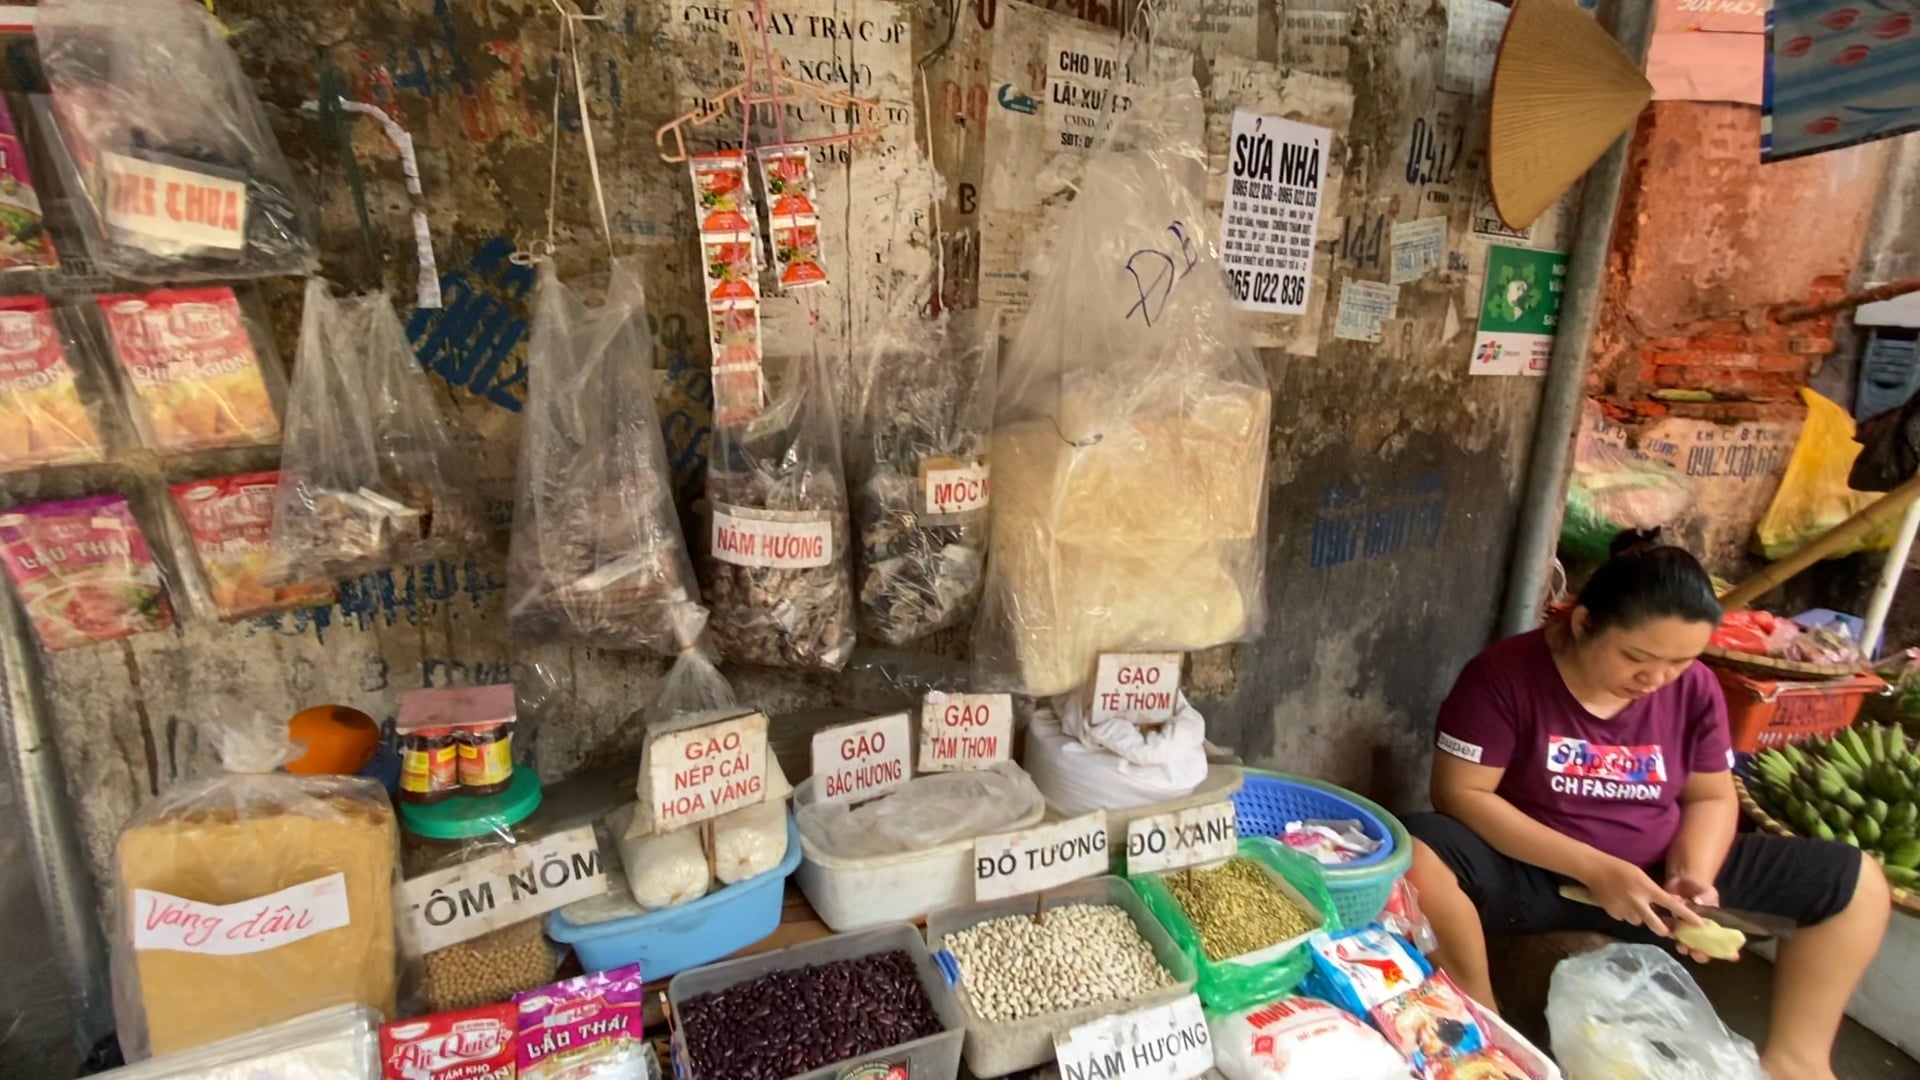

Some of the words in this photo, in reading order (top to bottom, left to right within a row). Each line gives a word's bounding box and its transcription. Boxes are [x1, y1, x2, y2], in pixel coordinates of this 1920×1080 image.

[1060, 50, 1089, 75] CHO
[1234, 117, 1273, 181] SỬA
[1279, 138, 1320, 189] NHÀ
[1253, 272, 1279, 304] 022
[1281, 275, 1305, 307] 836
[762, 533, 823, 559] HƯƠNG
[1117, 666, 1160, 689] GẠO
[1125, 691, 1171, 711] THƠM
[944, 704, 990, 731] GẠO
[684, 731, 741, 761] GẠO
[840, 731, 886, 762] GẠO
[931, 731, 958, 760] TÁM
[961, 735, 998, 758] THƠM
[855, 759, 902, 792] HƯƠNG
[1551, 775, 1580, 795] CH
[1581, 778, 1662, 801] FASHION
[661, 793, 706, 820] HOA
[709, 775, 762, 806] VÀNG
[1024, 830, 1107, 870] TƯƠNG
[578, 1013, 629, 1039] THÁI
[1132, 1022, 1207, 1069] HƯƠNG
